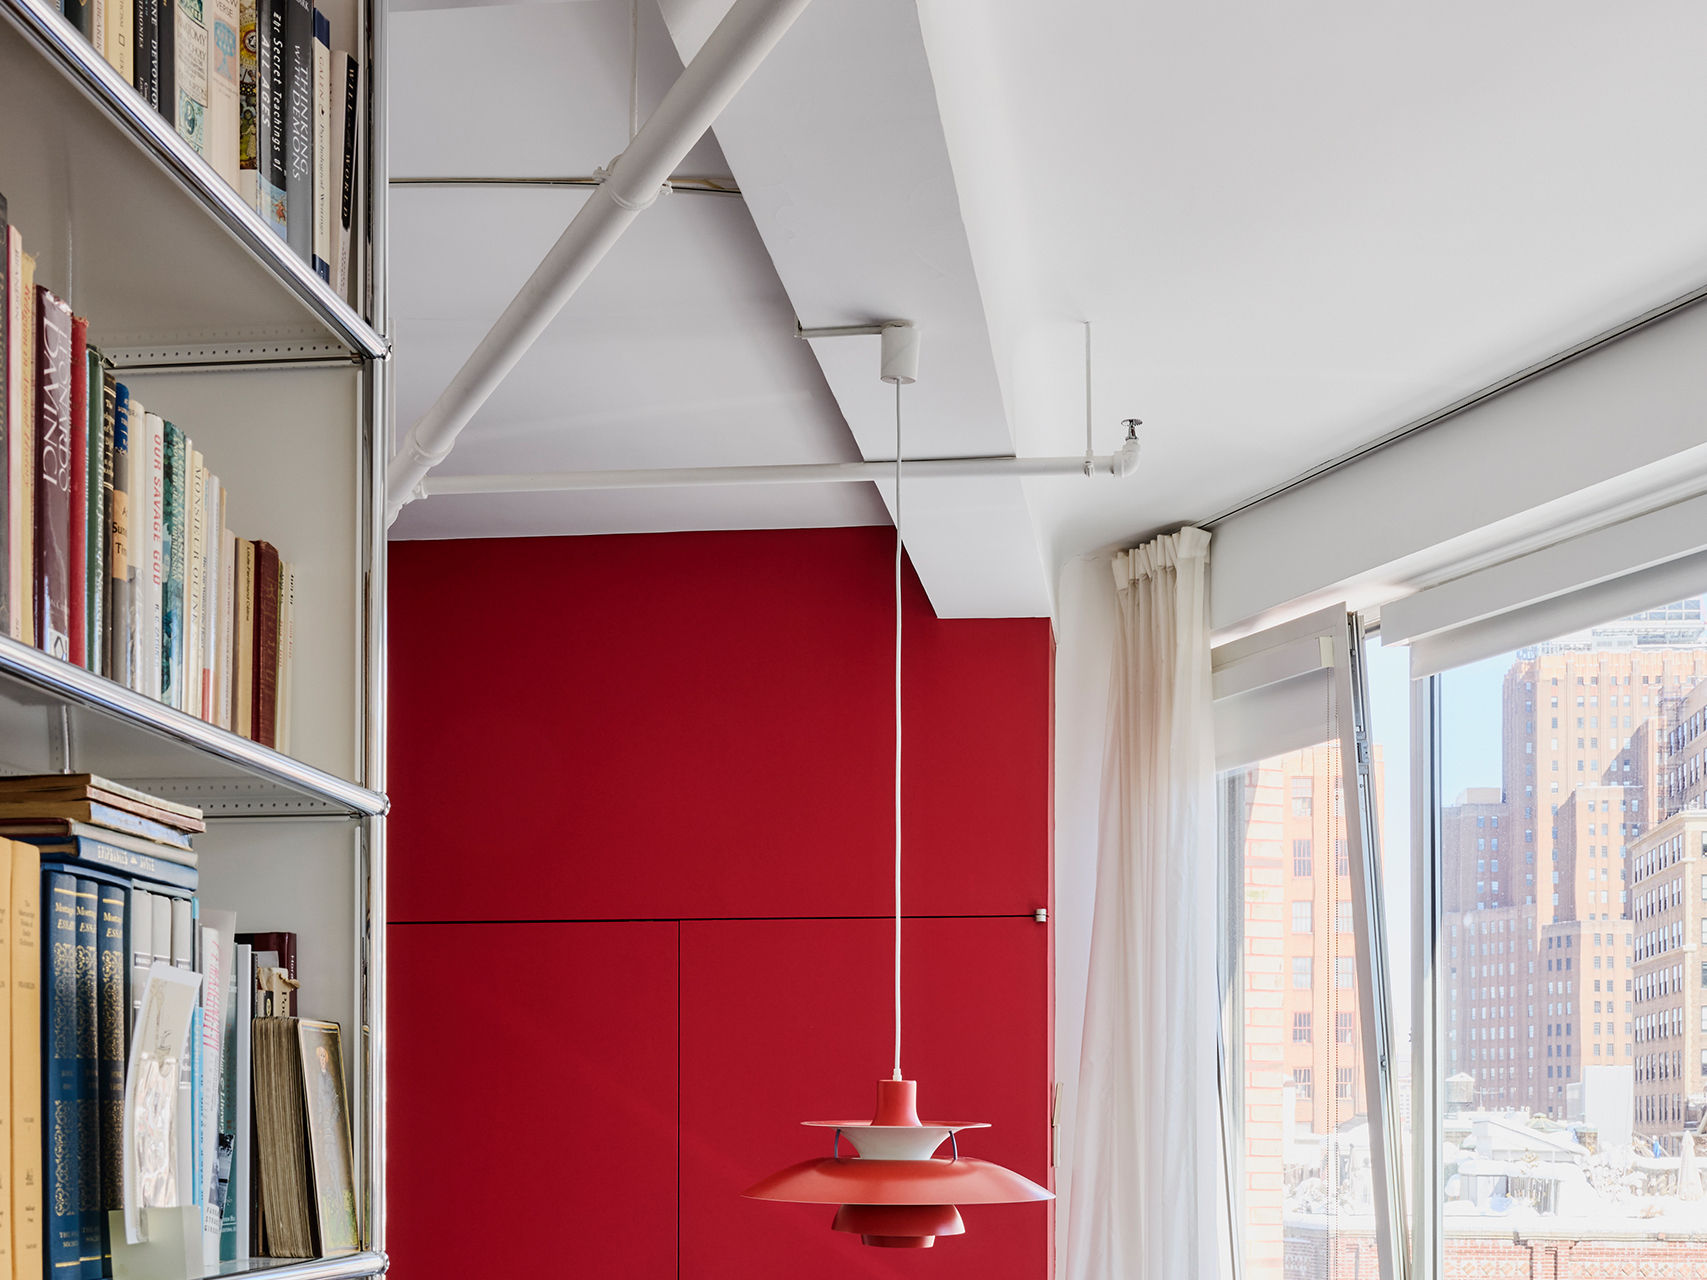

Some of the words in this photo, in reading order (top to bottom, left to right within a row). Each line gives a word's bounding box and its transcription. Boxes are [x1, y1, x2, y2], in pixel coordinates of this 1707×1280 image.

[262, 34, 270, 67] ALL
[273, 38, 283, 84] Secret
[262, 76, 270, 127] AGES
[347, 69, 355, 112] WILL
[273, 91, 282, 151] Teachings
[293, 89, 301, 181] DEMONS
[300, 67, 309, 175] THINKING
[273, 158, 282, 171] of
[343, 154, 352, 217] WORLD
[22, 284, 31, 346] Religion
[58, 330, 69, 490] LEONARDO
[23, 432, 31, 488] History
[154, 434, 162, 471] OUR
[96, 511, 104, 547] Jesus
[153, 476, 161, 543] SAVAGE
[194, 467, 202, 560] MONSIEUR
[153, 550, 161, 586] GOD
[98, 845, 129, 866] EPIPHANIES
[140, 856, 156, 872] JOYCE
[203, 964, 220, 1050] MARINETTI
